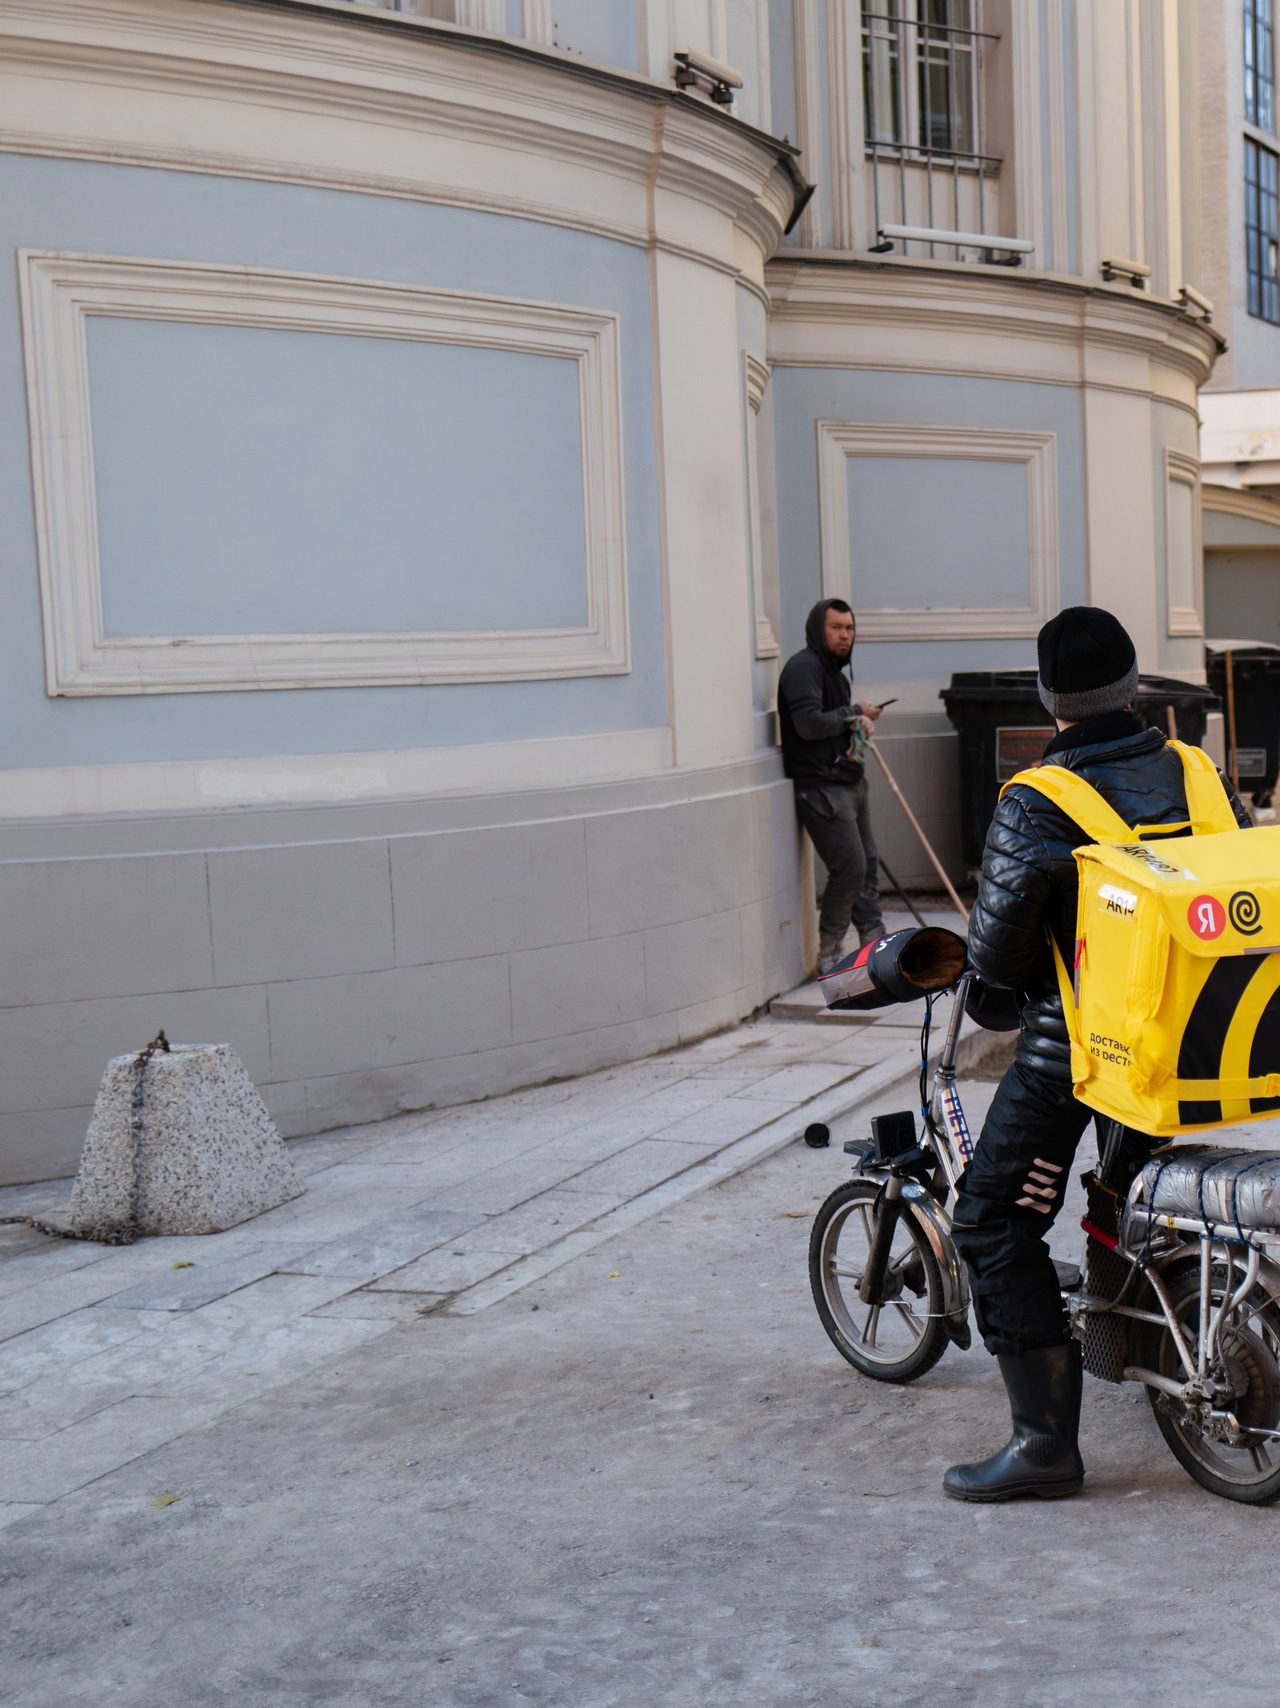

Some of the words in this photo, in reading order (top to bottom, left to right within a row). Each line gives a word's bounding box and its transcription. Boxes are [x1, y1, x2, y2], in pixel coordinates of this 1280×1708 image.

[1197, 902, 1216, 933] Я
[1090, 1032, 1132, 1056] доставк
[1090, 1045, 1100, 1057] из
